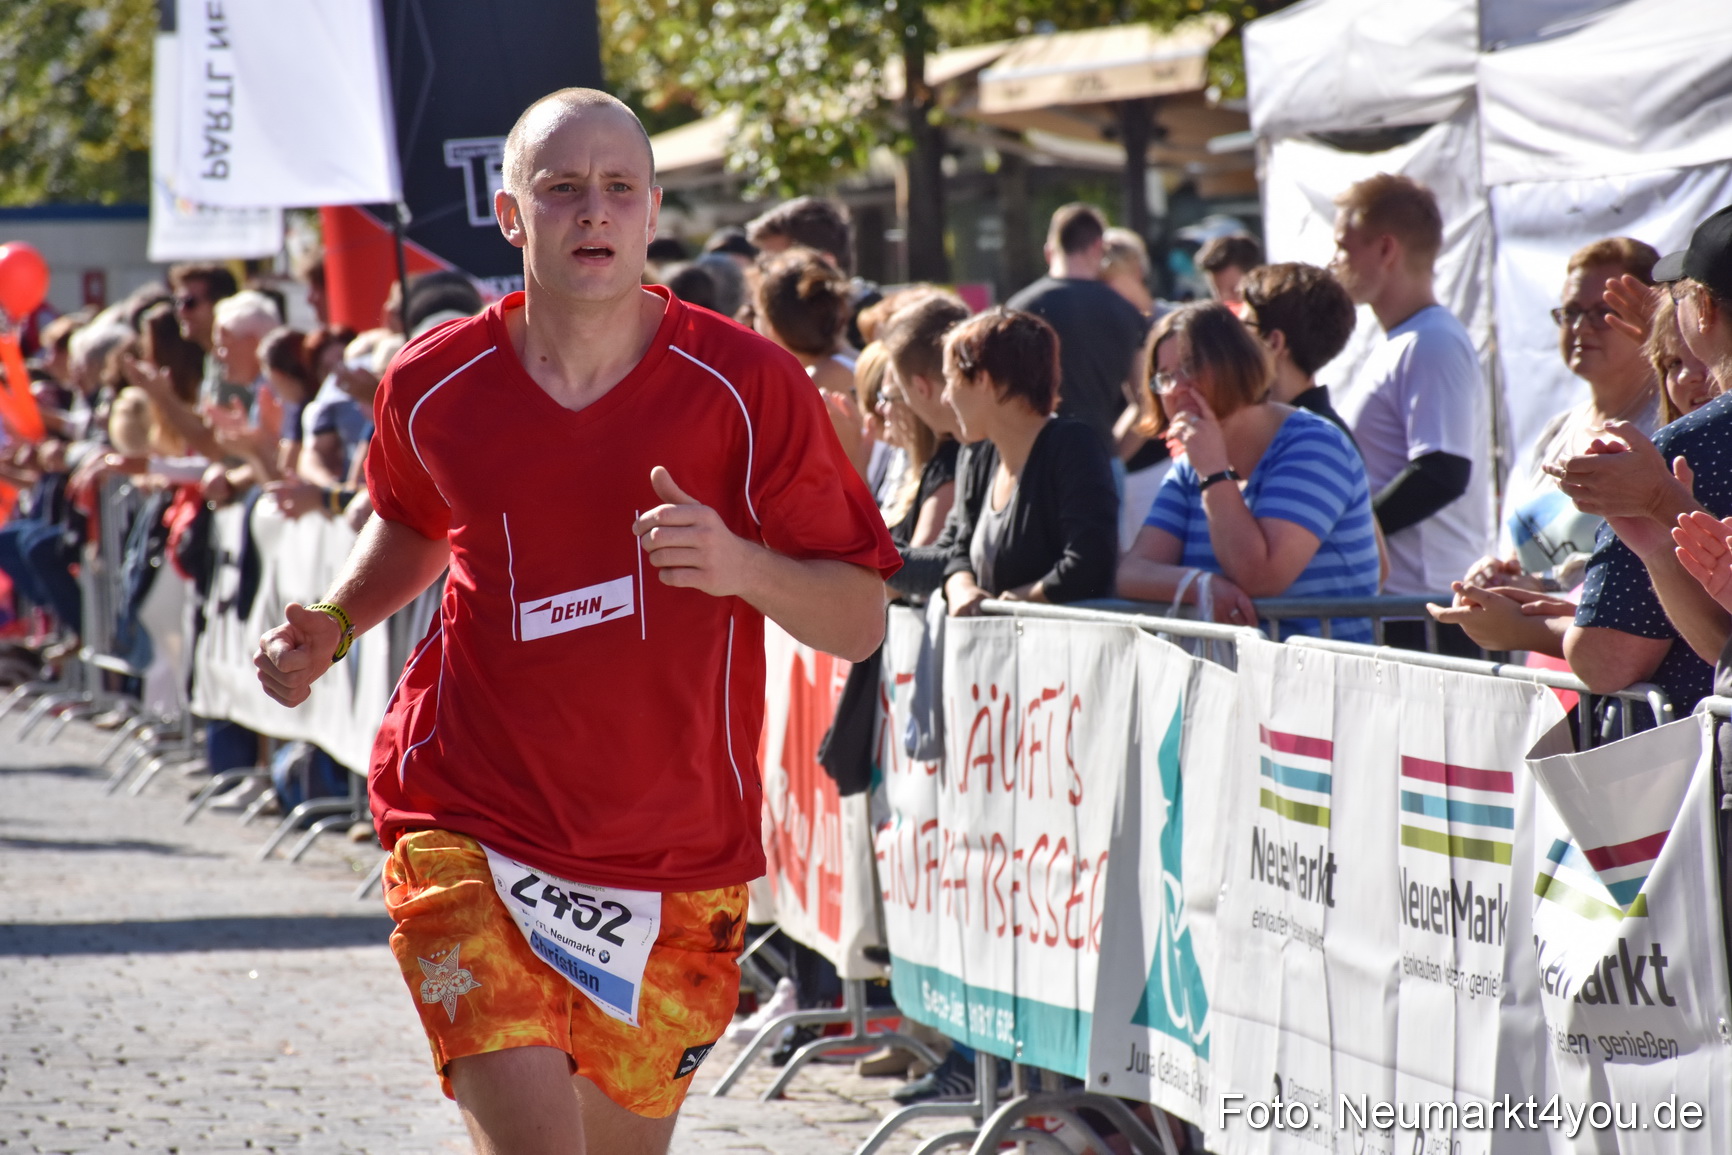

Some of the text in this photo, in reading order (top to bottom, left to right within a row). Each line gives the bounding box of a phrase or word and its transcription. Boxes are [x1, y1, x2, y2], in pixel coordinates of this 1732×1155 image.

[551, 596, 602, 624] DEHN
[511, 861, 633, 948] 2452
[550, 928, 596, 957] Neumarkt
[530, 930, 600, 993] Christian
[1599, 1030, 1679, 1062] genießen
